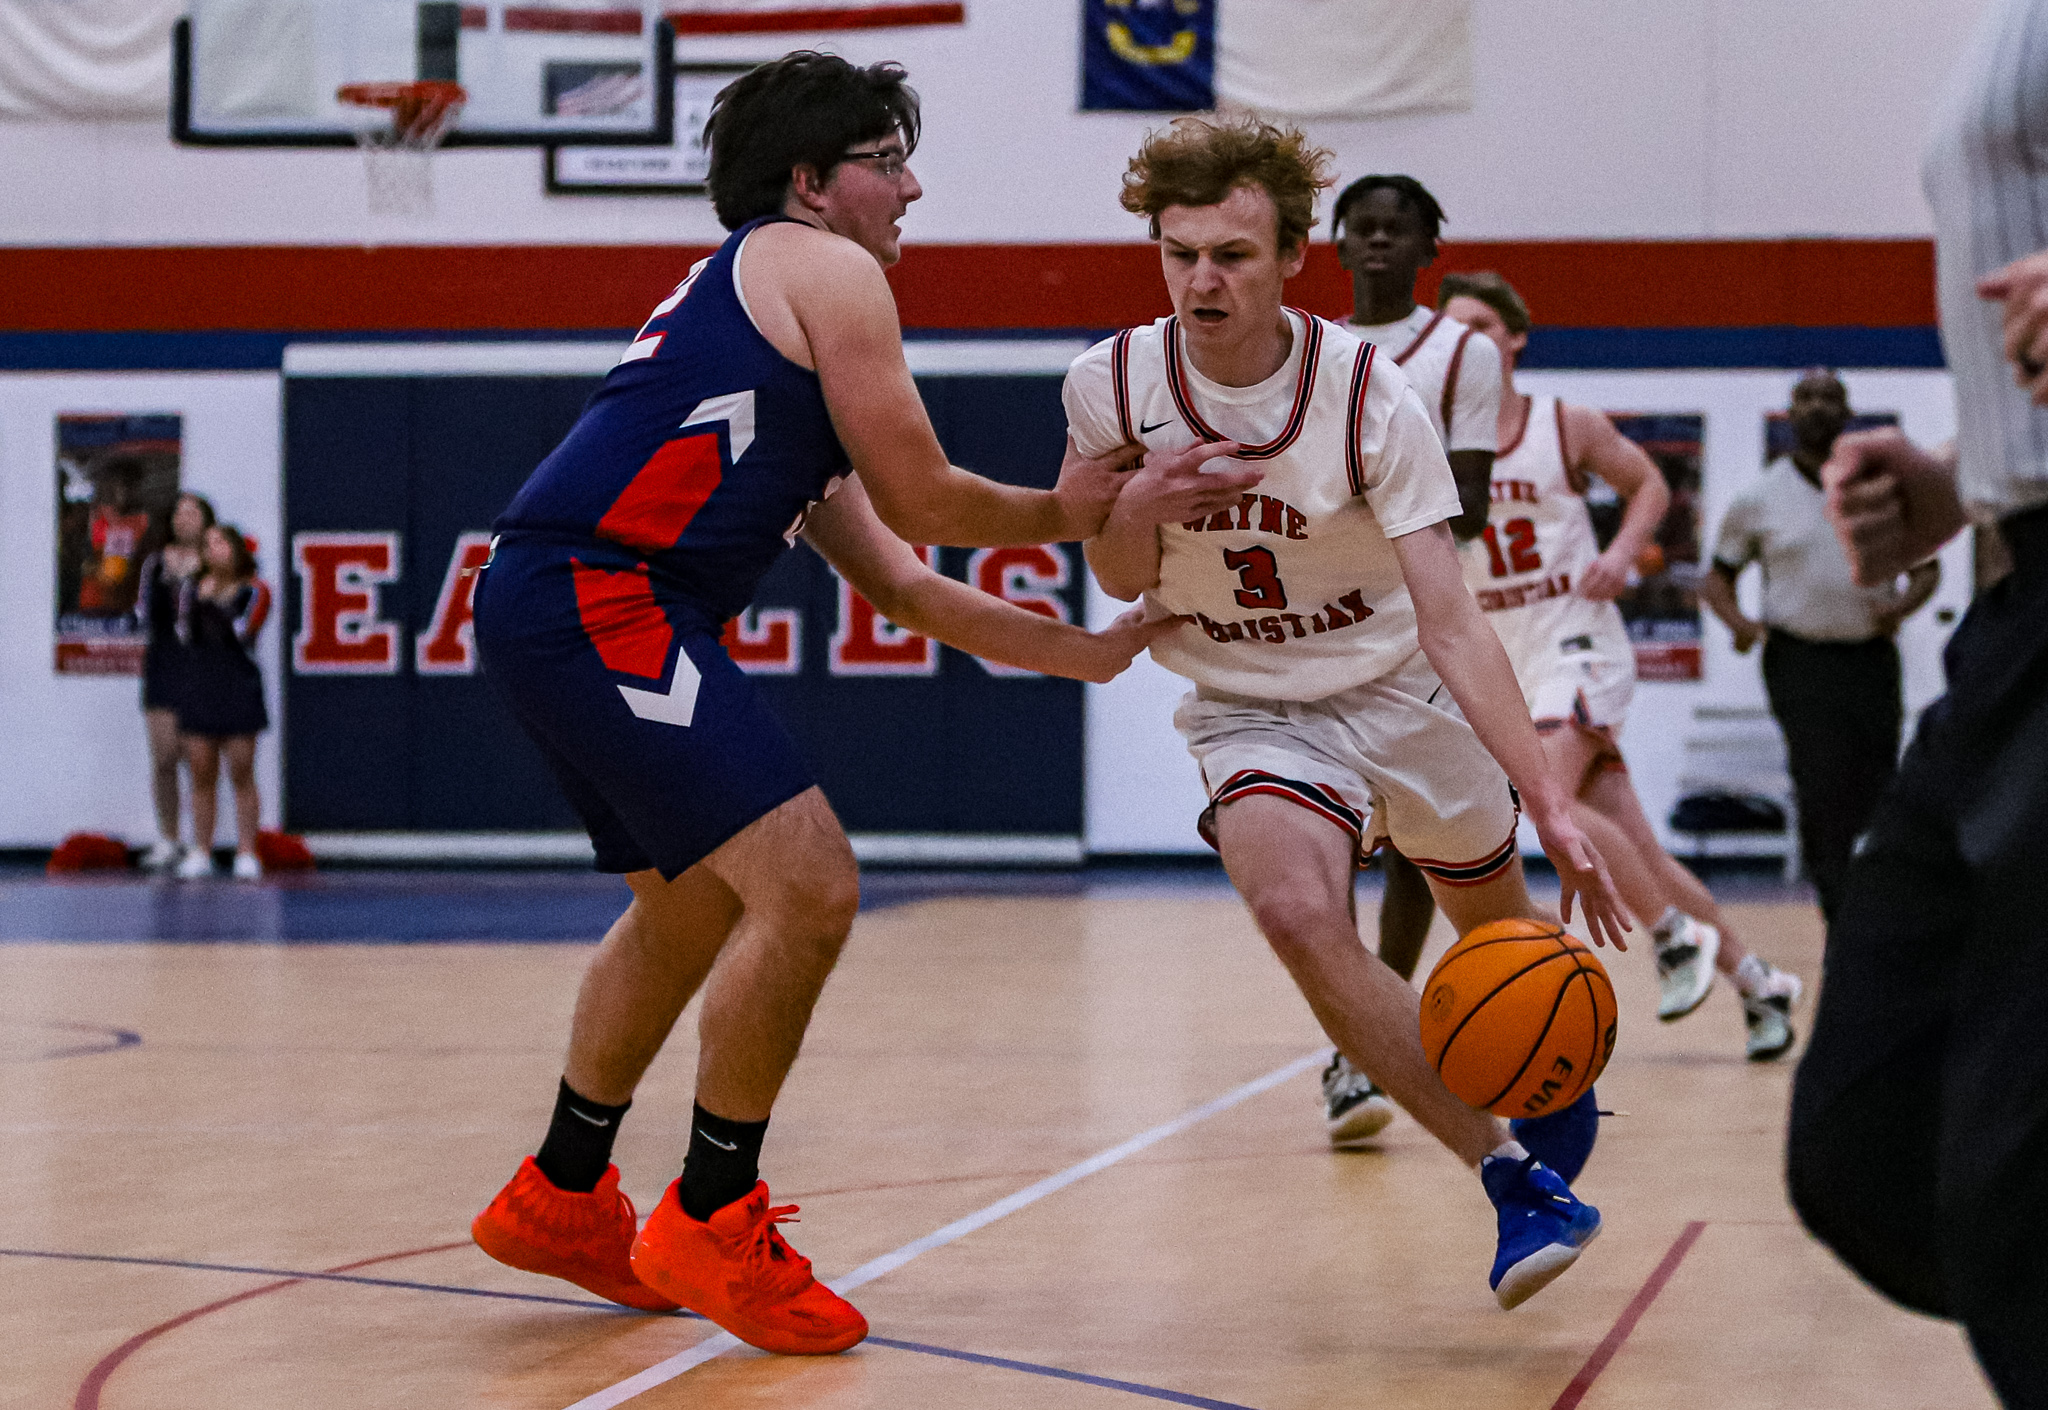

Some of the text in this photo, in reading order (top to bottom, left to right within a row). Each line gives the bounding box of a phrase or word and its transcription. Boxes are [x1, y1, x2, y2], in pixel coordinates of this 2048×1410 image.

[1222, 545, 1288, 610] 3
[1482, 518, 1542, 578] 12
[292, 530, 1073, 677] EALES
